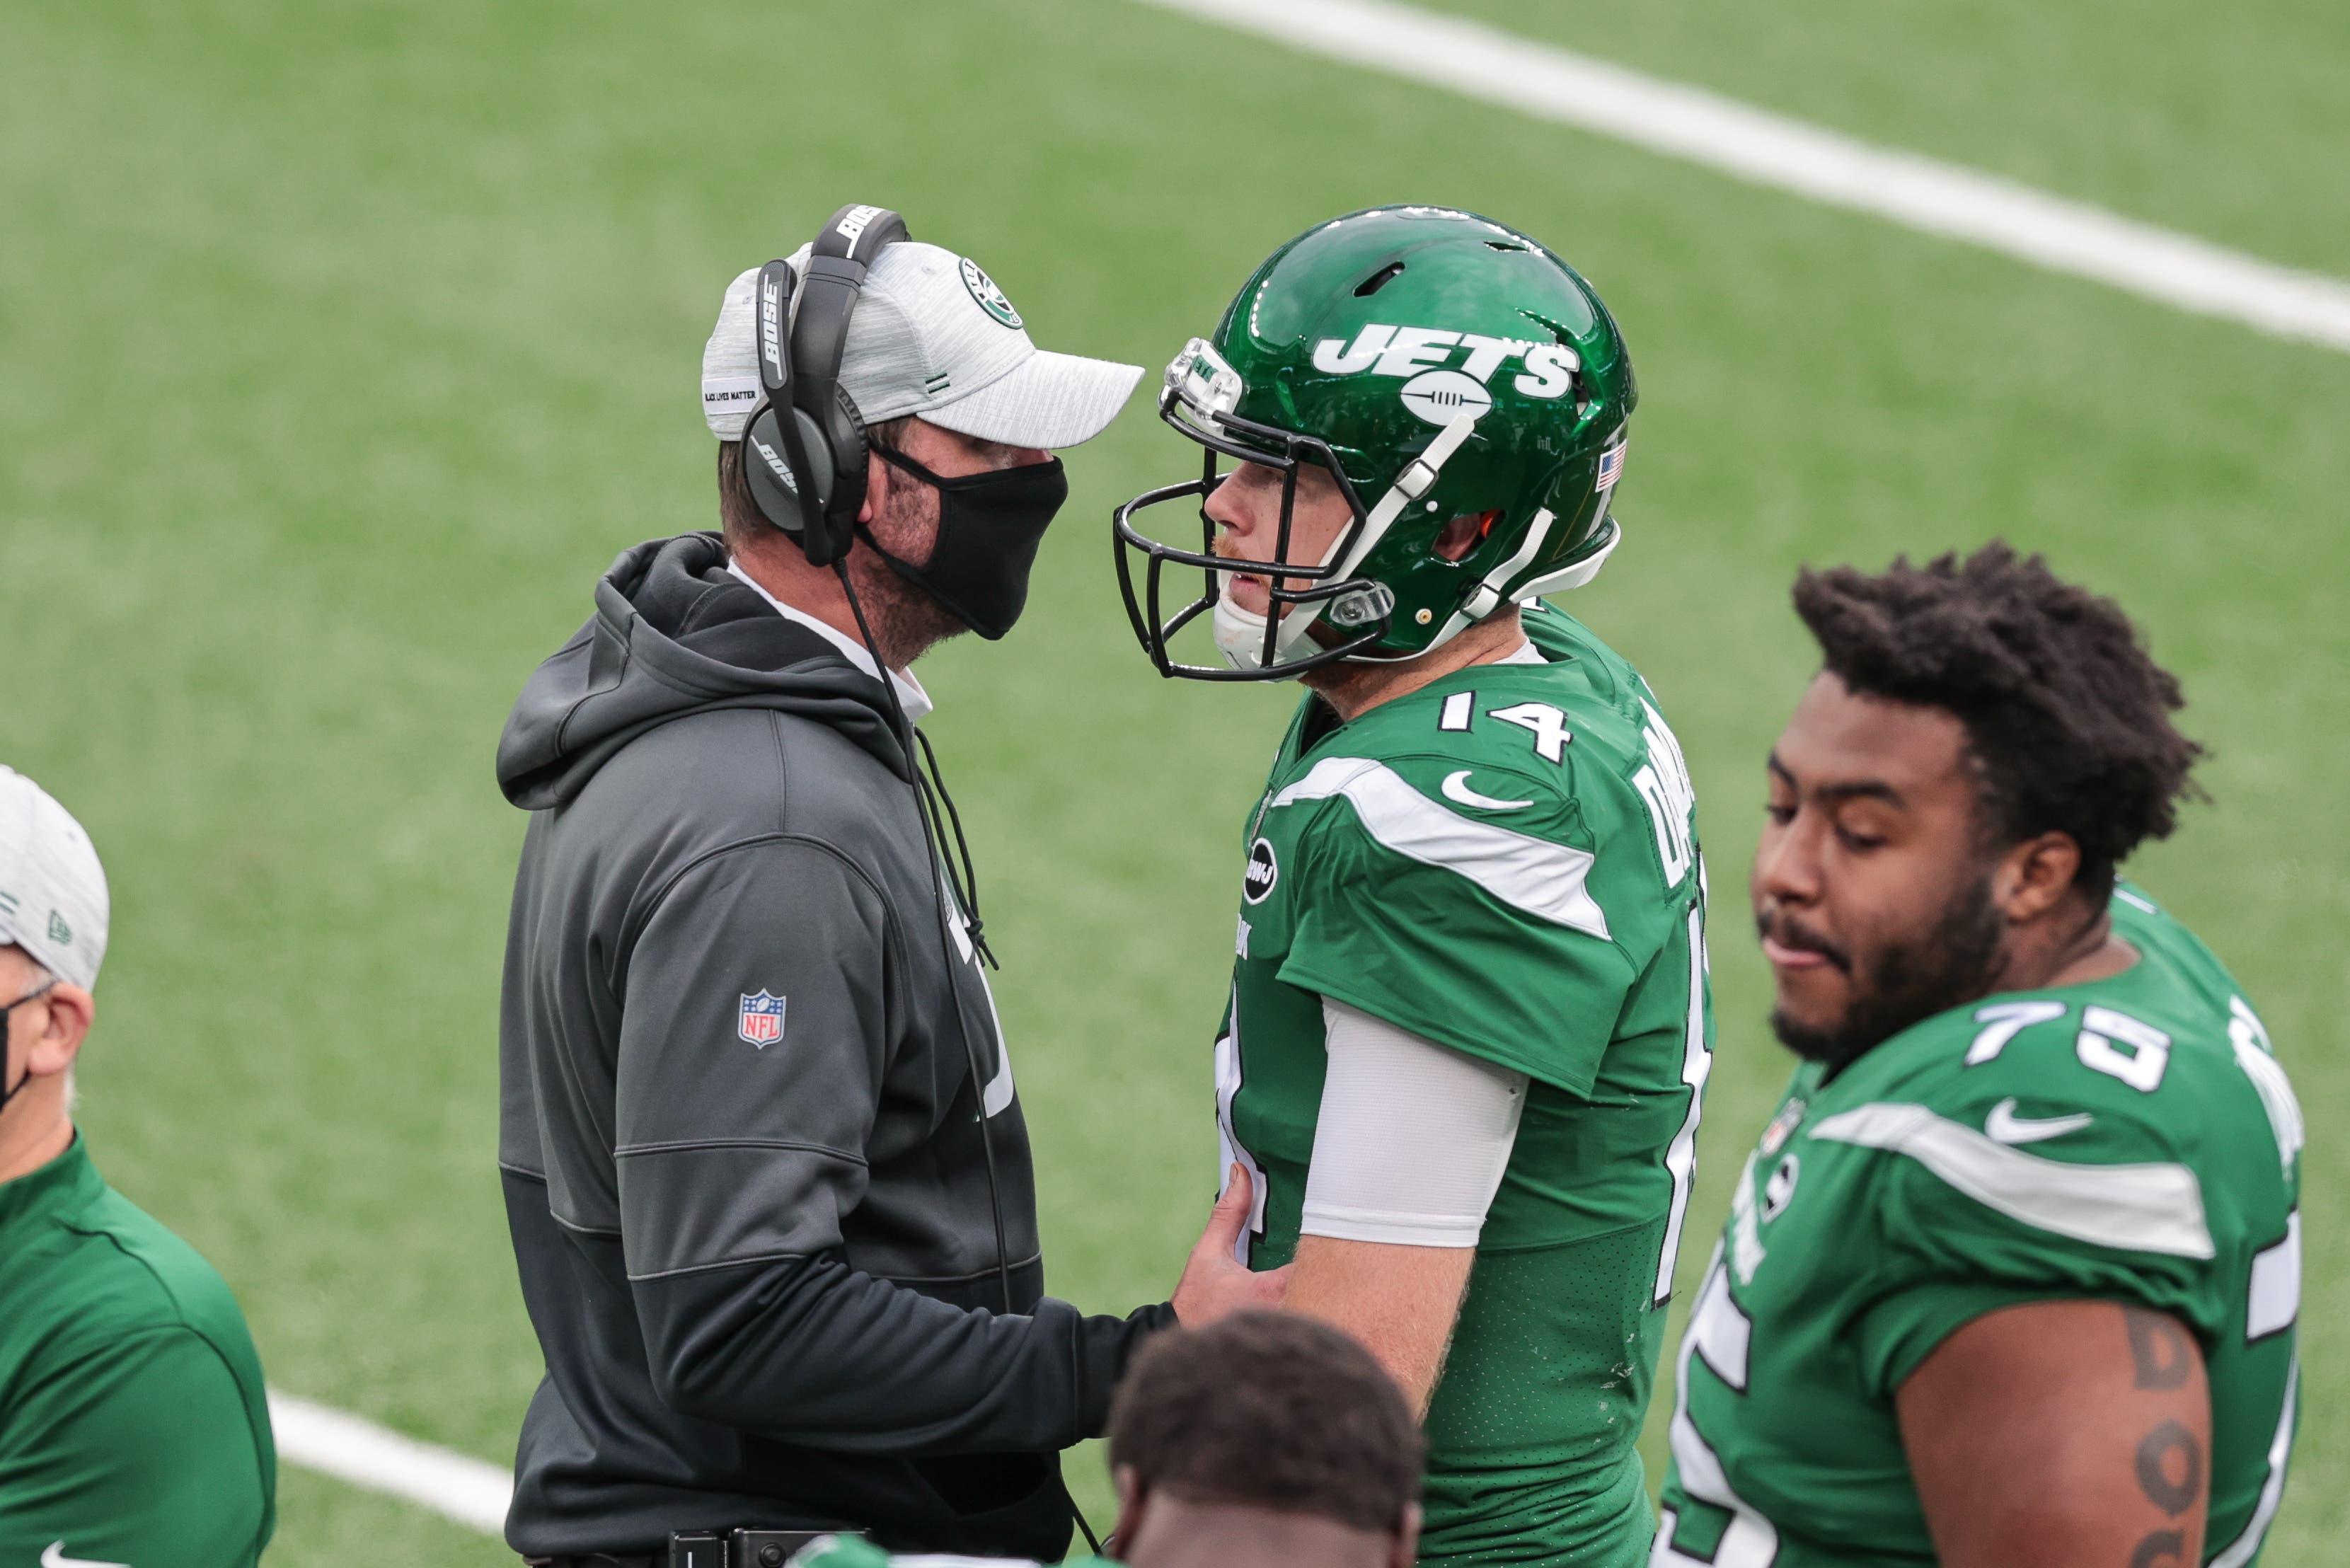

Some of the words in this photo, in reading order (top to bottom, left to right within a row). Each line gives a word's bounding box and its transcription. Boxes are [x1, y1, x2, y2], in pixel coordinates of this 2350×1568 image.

[836, 204, 885, 259] BOS
[764, 274, 783, 381] BOSE
[1311, 323, 1580, 399] JETS
[716, 392, 730, 401] LIVES
[730, 390, 756, 400] MATTER
[751, 434, 824, 503] BOS
[1437, 690, 1574, 767] 14
[744, 1015, 778, 1039] NFL
